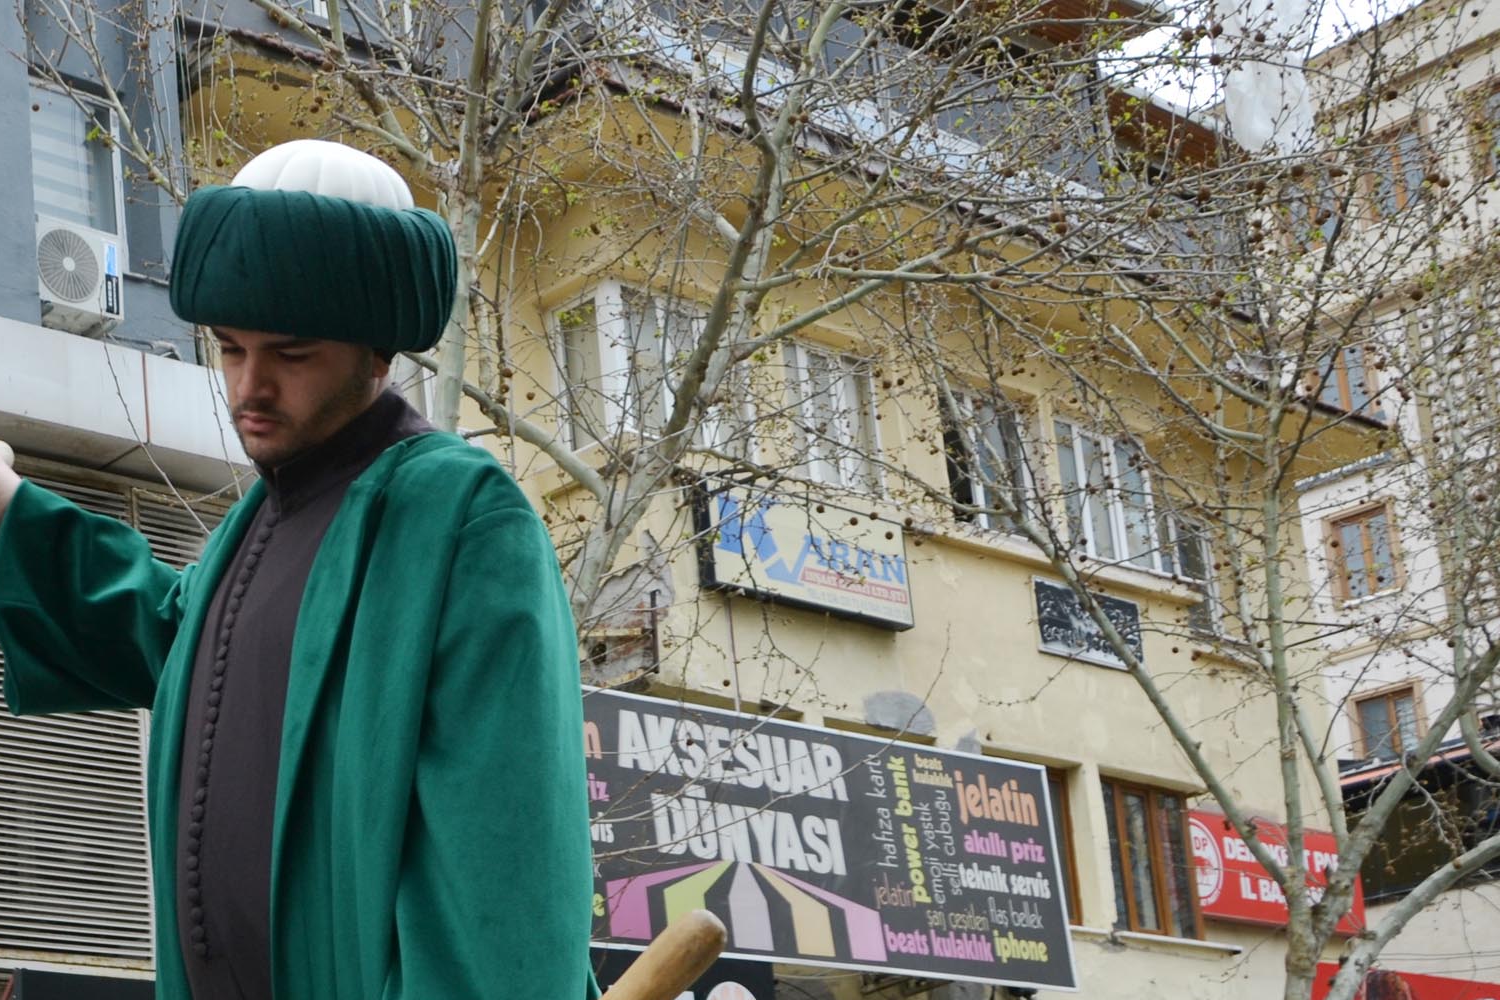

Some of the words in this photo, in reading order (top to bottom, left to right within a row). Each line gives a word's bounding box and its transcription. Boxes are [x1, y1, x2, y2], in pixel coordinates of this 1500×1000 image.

[617, 709, 849, 801] AKSESUAR
[886, 755, 912, 817] bank
[954, 769, 1039, 827] jelatin
[651, 785, 848, 876] DÜNYASI
[1010, 838, 1046, 865] priz
[901, 823, 932, 903] power
[958, 862, 1010, 894] teknik
[1010, 872, 1052, 900] servis
[884, 923, 929, 956] beats
[993, 928, 1049, 964] iphone
